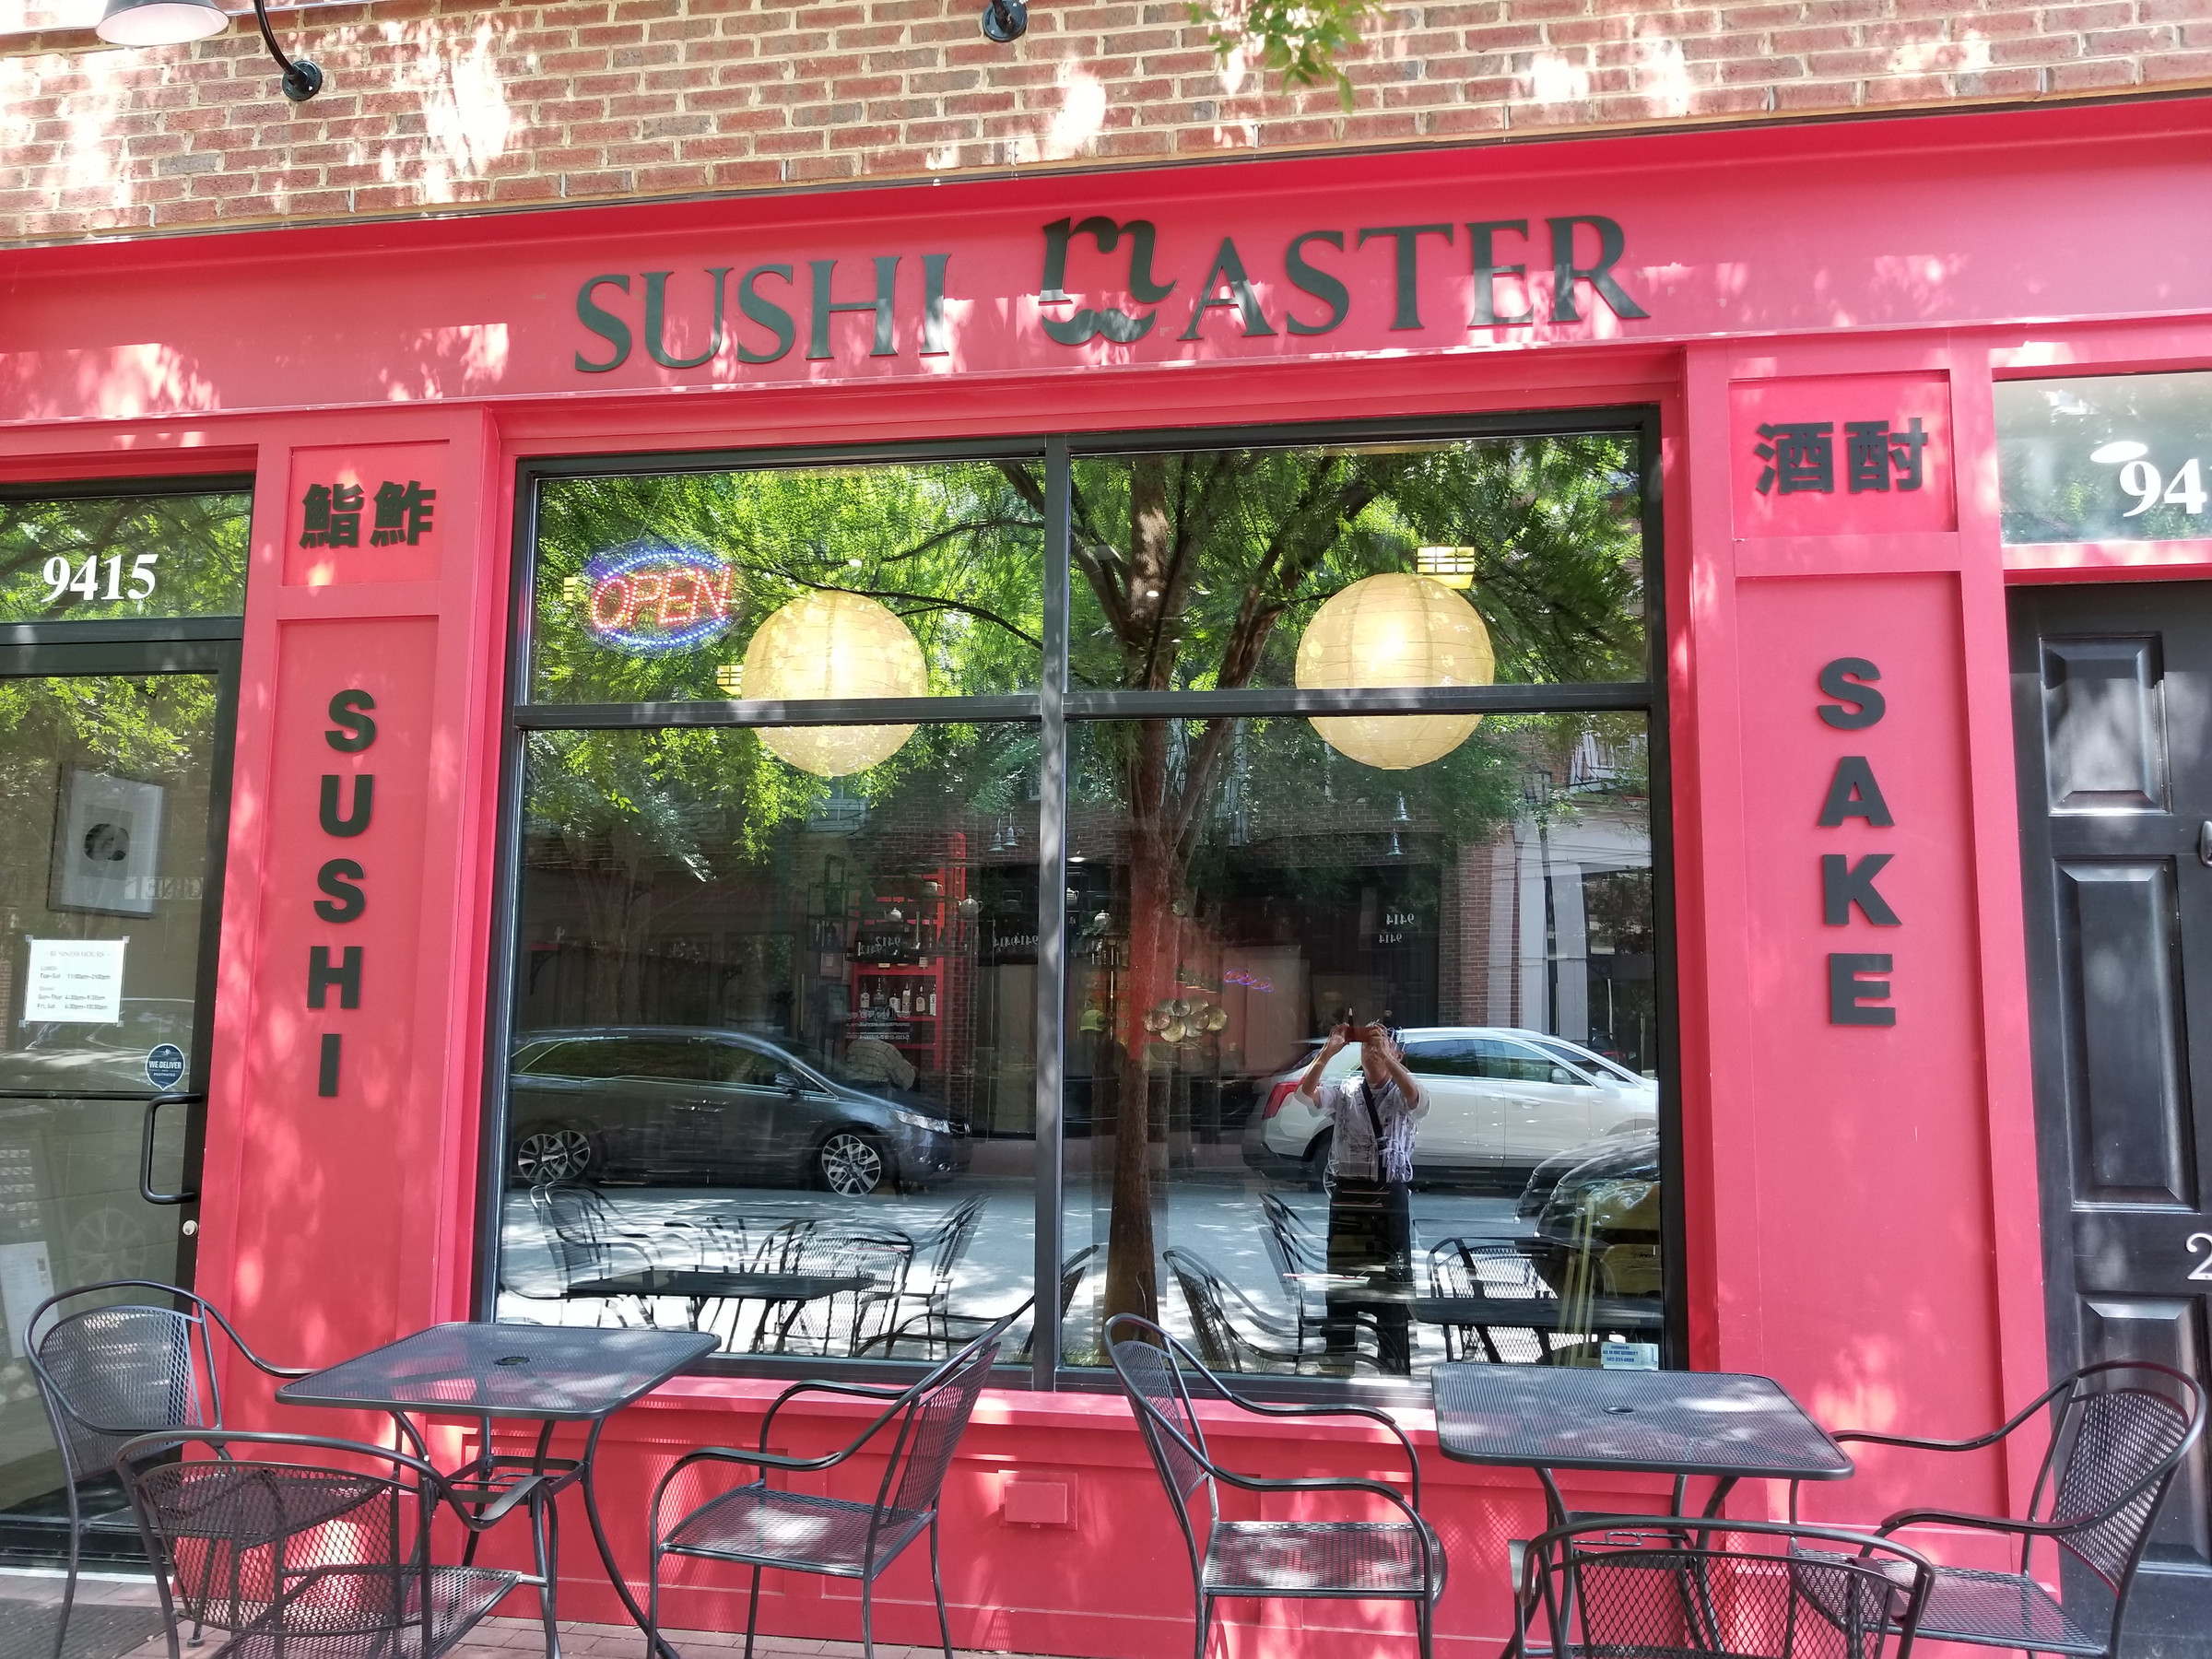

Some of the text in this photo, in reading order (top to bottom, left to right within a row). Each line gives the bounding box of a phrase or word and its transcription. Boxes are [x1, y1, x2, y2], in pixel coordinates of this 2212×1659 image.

[574, 215, 1652, 373] SUSHI MASTER
[1753, 417, 1929, 496] 酒酎
[41, 553, 159, 603] 9415
[592, 564, 734, 631] OPEN
[1817, 657, 1903, 1028] SAKE
[306, 688, 378, 1098] SUSHI
[148, 1060, 182, 1069] WE DELIVER
[2185, 1232, 2212, 1280] 2
